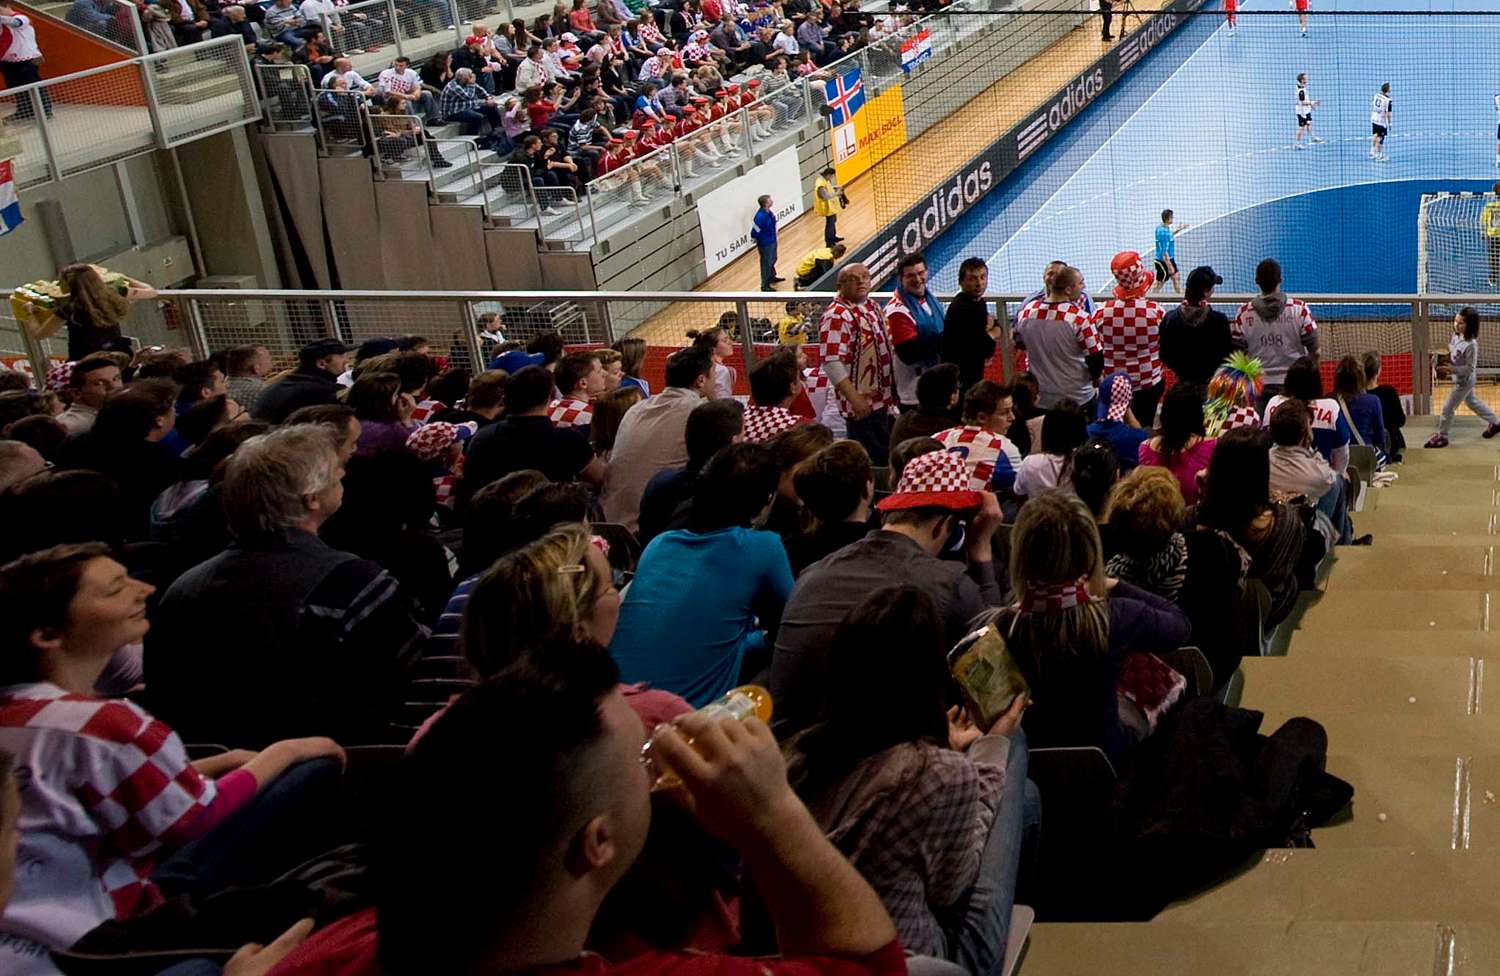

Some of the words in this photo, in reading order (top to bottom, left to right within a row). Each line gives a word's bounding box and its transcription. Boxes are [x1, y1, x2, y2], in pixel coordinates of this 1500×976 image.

[1049, 68, 1103, 130] adidas
[859, 131, 879, 149] MAX
[902, 161, 992, 255] adidas
[715, 247, 728, 261] TU
[729, 235, 748, 252] SAM
[1260, 335, 1284, 346] 098
